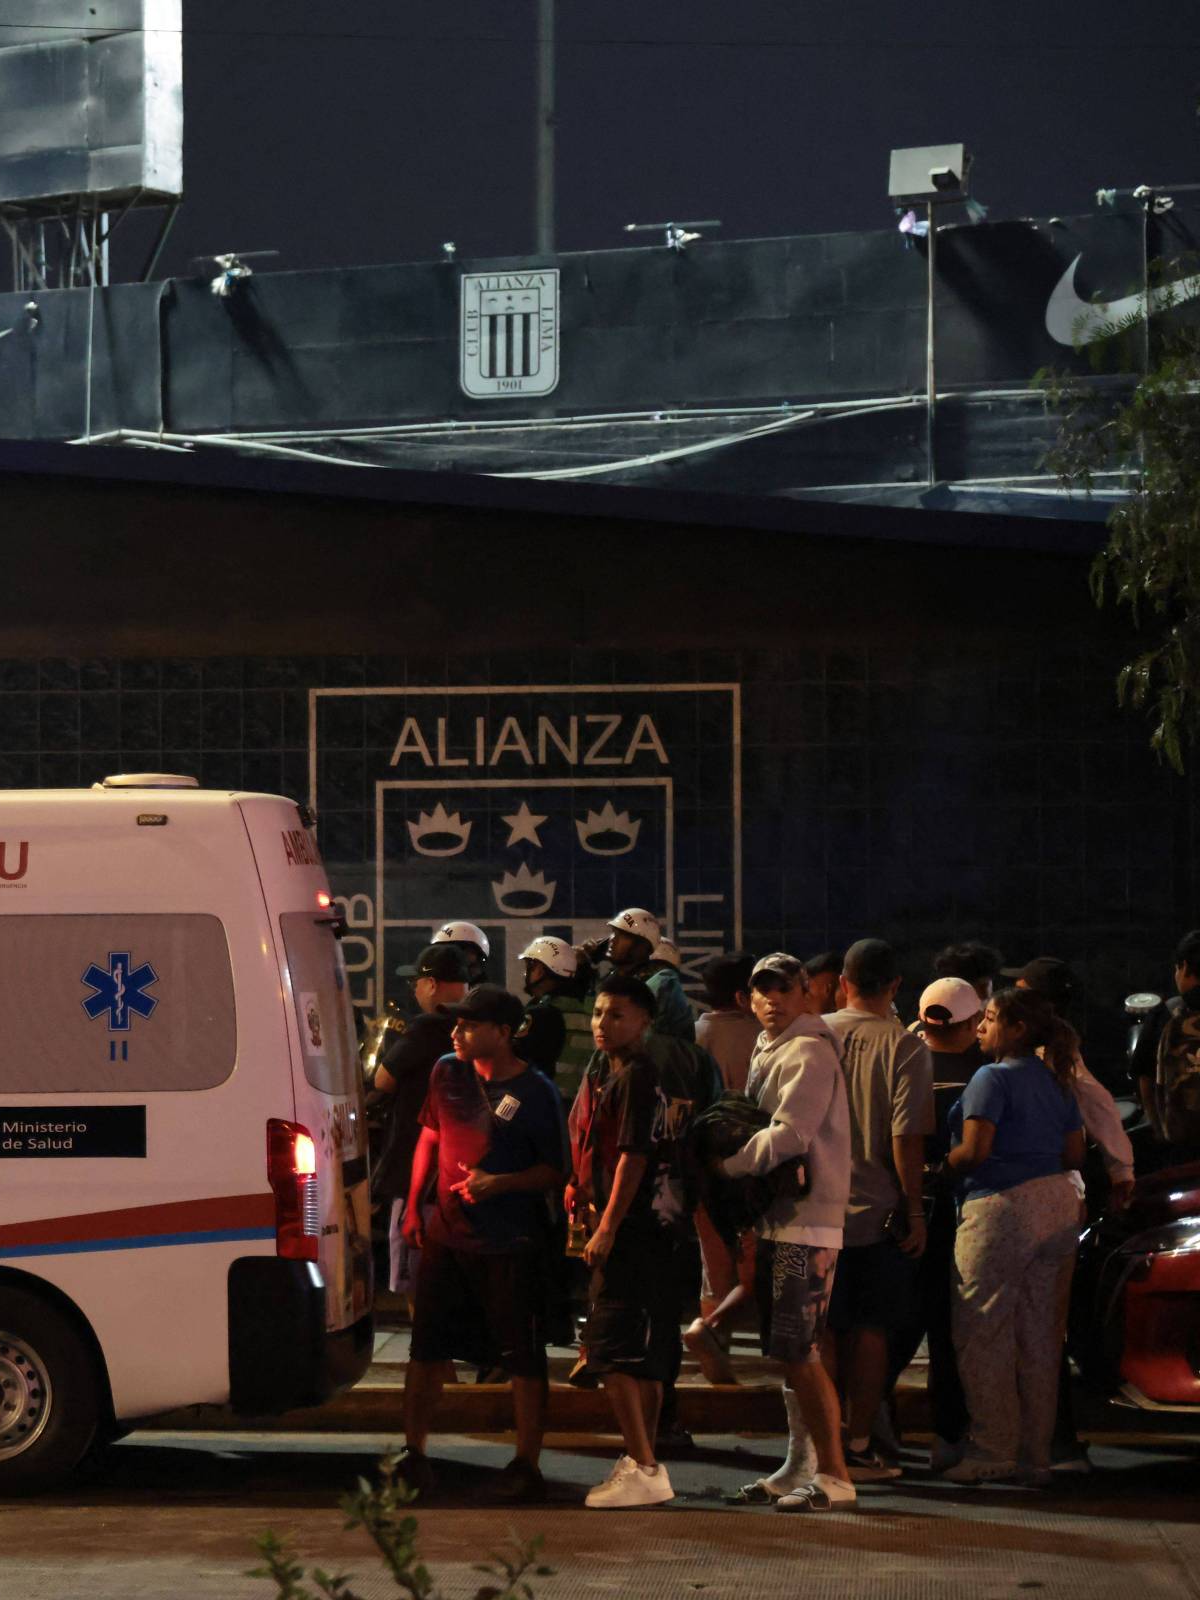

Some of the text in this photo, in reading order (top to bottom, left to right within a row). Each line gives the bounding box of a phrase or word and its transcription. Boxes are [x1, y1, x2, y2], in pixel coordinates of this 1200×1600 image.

[473, 274, 546, 290] ALIANZA
[466, 309, 479, 358] CLUB
[541, 306, 554, 353] LIMA
[496, 379, 523, 391] 1901
[389, 714, 670, 767] ALIANZA
[2, 1121, 88, 1134] Ministerio
[2, 1137, 74, 1150] de Salud
